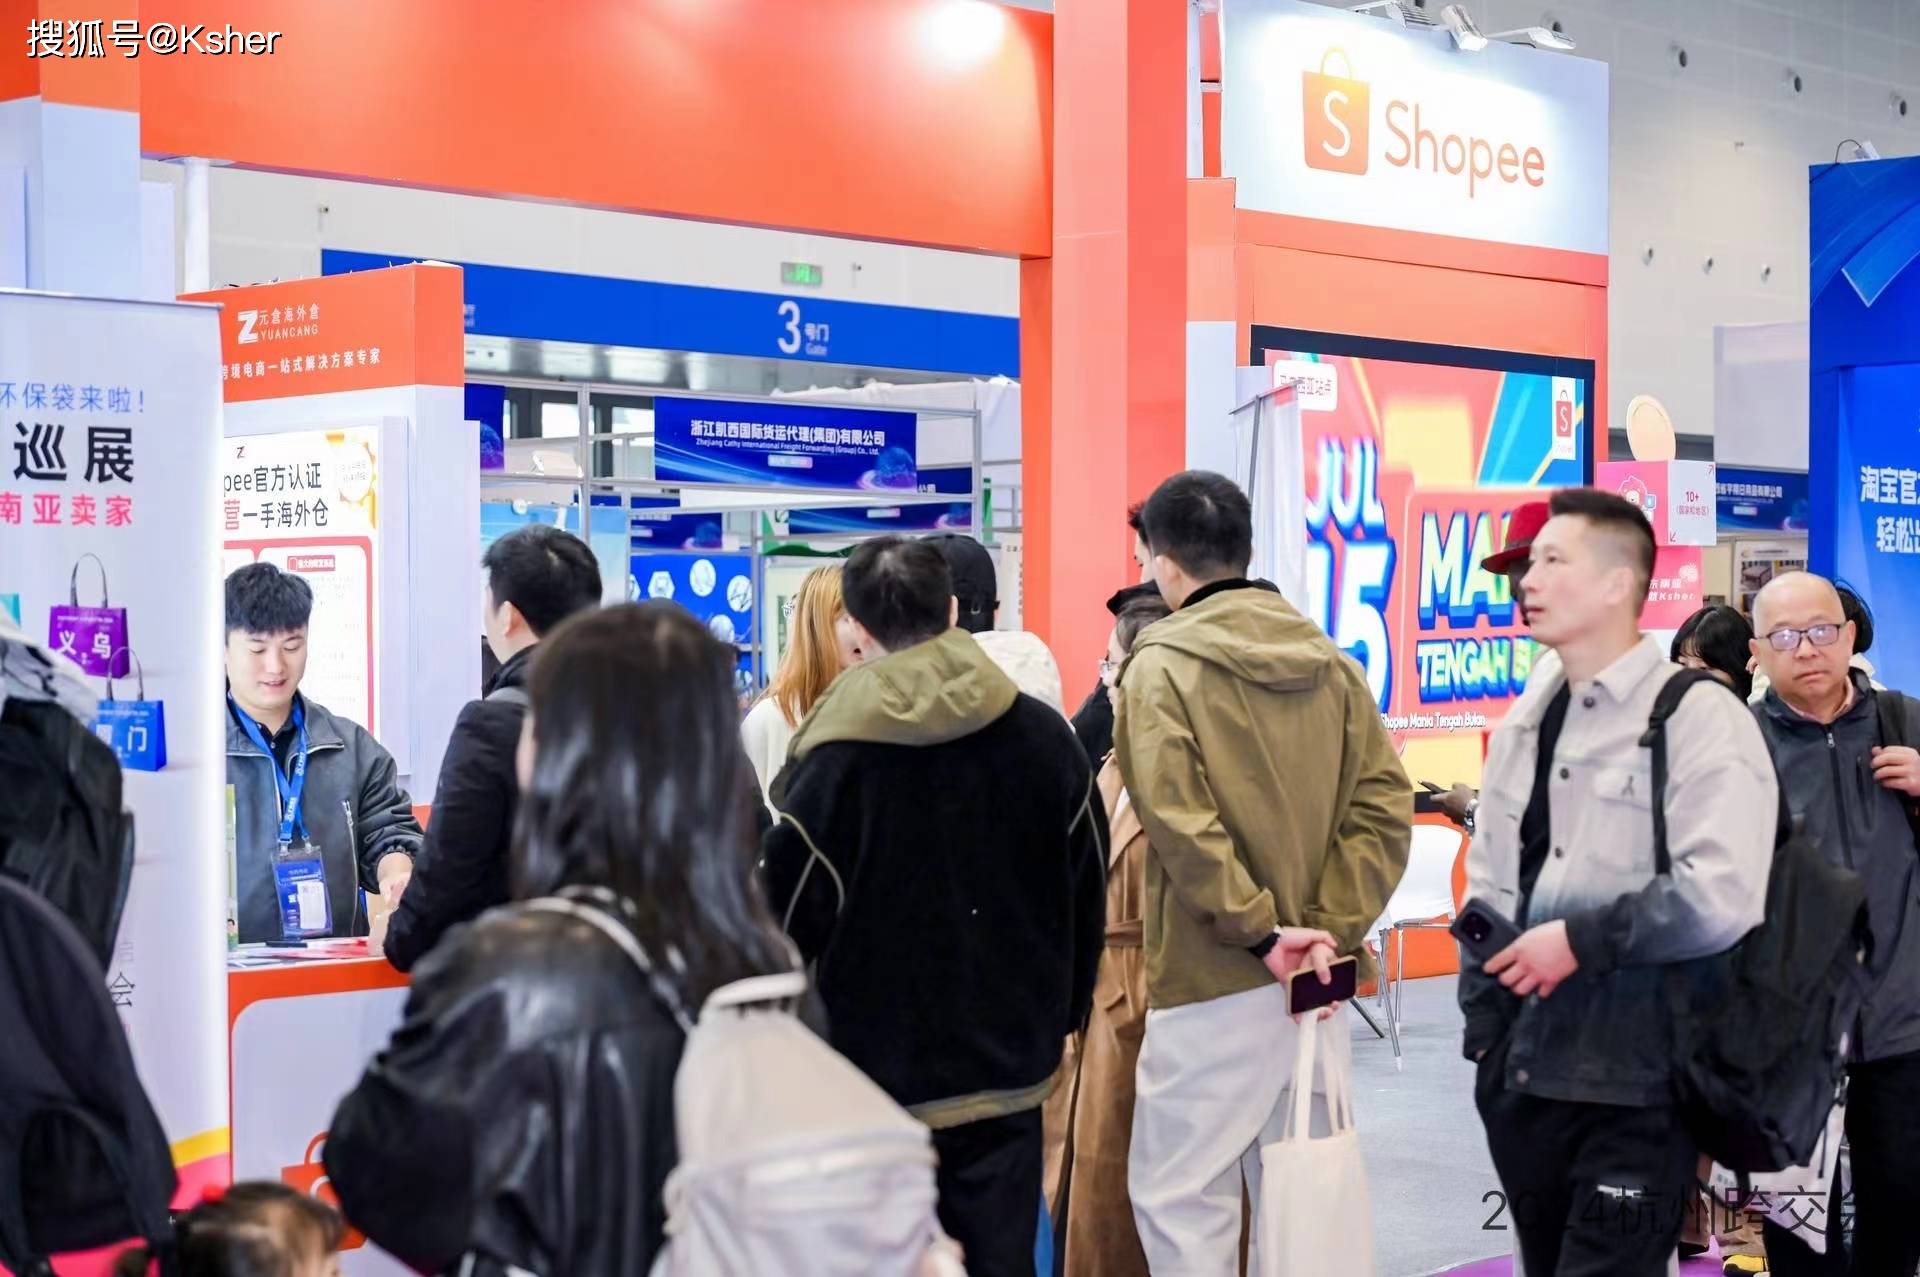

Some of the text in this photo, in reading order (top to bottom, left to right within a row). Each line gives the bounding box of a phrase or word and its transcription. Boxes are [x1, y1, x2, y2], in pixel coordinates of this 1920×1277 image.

[1384, 100, 1545, 199] Shopee
[260, 324, 319, 341] YUANCANG
[777, 300, 801, 354] 3
[804, 322, 830, 342] 号门
[696, 438, 723, 448] Zhejiang
[724, 440, 741, 449] Cathy
[742, 441, 780, 450] International
[781, 443, 801, 453] Freight
[802, 444, 835, 454] Forwarding
[1306, 436, 1387, 535] JUL
[1685, 490, 1700, 502] 10+
[1860, 465, 1920, 505] 淘宝官
[1307, 537, 1397, 712] 15
[1417, 638, 1511, 702] TENGAH
[1381, 711, 1487, 734] Shopee Mania Tengah Bulan
